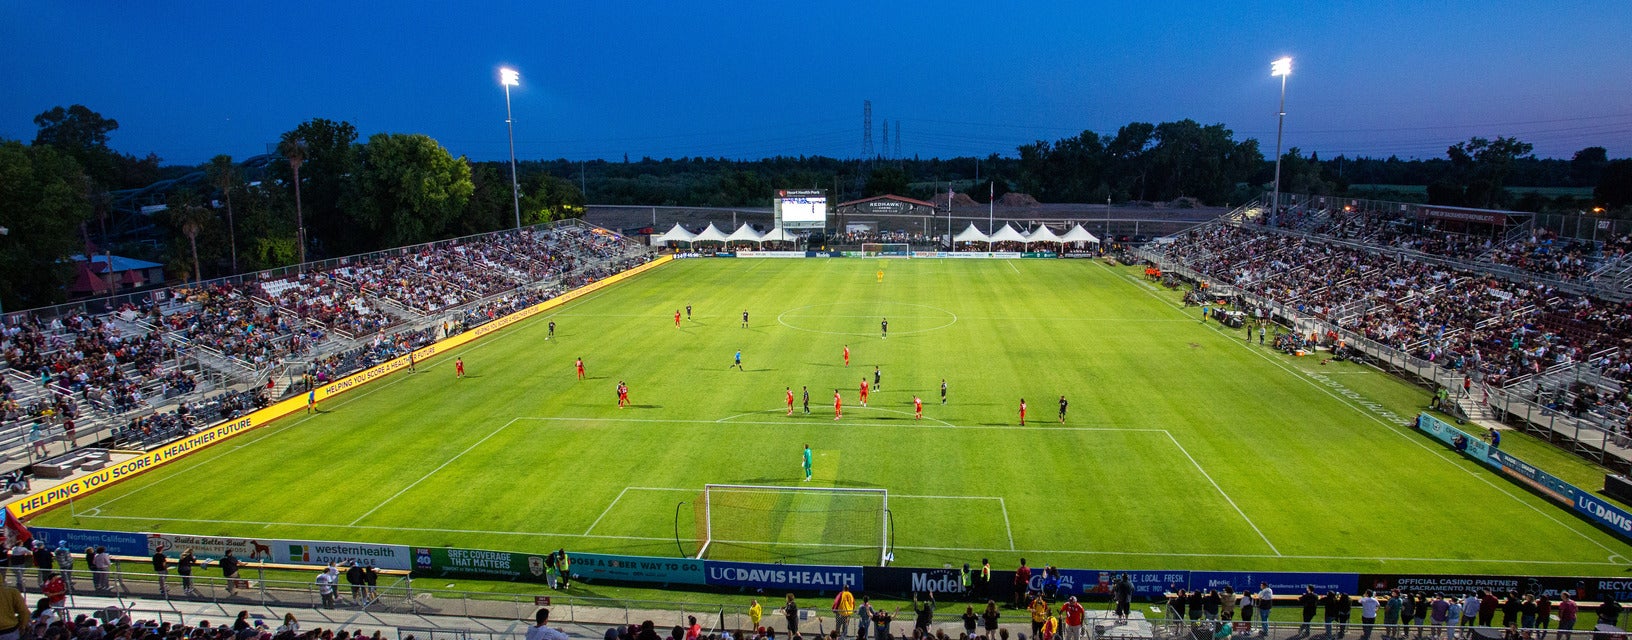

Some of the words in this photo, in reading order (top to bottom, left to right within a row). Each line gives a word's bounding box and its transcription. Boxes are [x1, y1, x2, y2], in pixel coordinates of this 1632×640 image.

[1598, 220, 1610, 229] 207
[155, 292, 165, 300] 113
[326, 379, 353, 395] HELPING
[354, 373, 365, 384] YOU
[367, 366, 385, 379] SCORE
[417, 346, 435, 359] FUTURE
[20, 483, 80, 513] HELPING
[83, 471, 109, 489] YOU
[112, 457, 151, 479] SCORE
[154, 453, 162, 462] A
[164, 431, 216, 459] HEALTHIER
[218, 417, 252, 438] FUTURE
[67, 533, 100, 541] Northern
[101, 534, 136, 544] California
[174, 536, 194, 544] Build
[201, 537, 225, 546] Better
[315, 545, 395, 557] westernhealth
[447, 550, 469, 558] SRFC
[470, 550, 512, 562] COVERAGE
[417, 555, 431, 565] 40
[450, 557, 473, 566] THAT
[473, 559, 511, 569] MATTERS
[570, 557, 595, 566] OOSE
[640, 562, 662, 570] WAY
[665, 563, 679, 571] TO
[682, 564, 700, 572] GO.
[788, 571, 856, 586] HEALTH
[1141, 574, 1160, 583] LOCAL.
[1163, 574, 1184, 583] FRESH.
[1209, 579, 1230, 587] Medic
[1475, 579, 1518, 587] PARTNER
